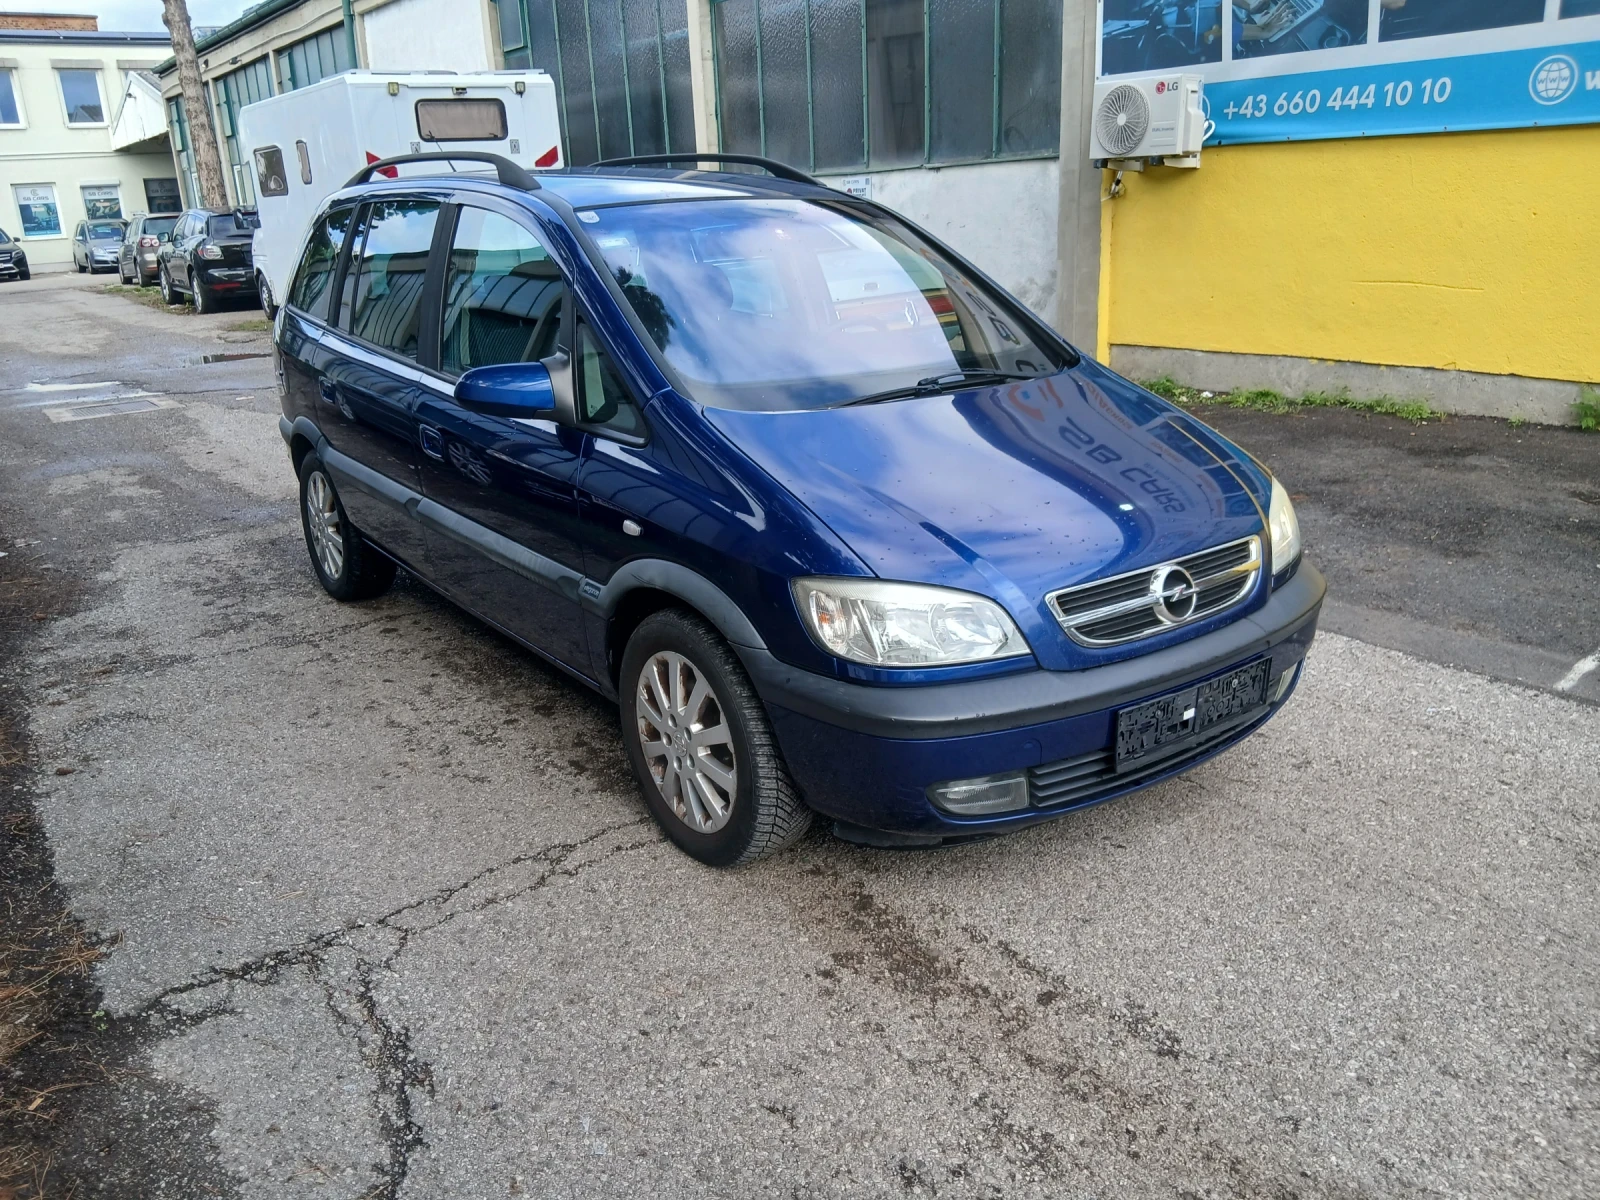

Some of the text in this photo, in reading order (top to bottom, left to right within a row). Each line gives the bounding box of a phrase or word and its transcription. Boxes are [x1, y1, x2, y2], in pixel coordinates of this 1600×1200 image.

[1167, 82, 1178, 91] LG
[1223, 77, 1452, 120] +43 660 444 10 10
